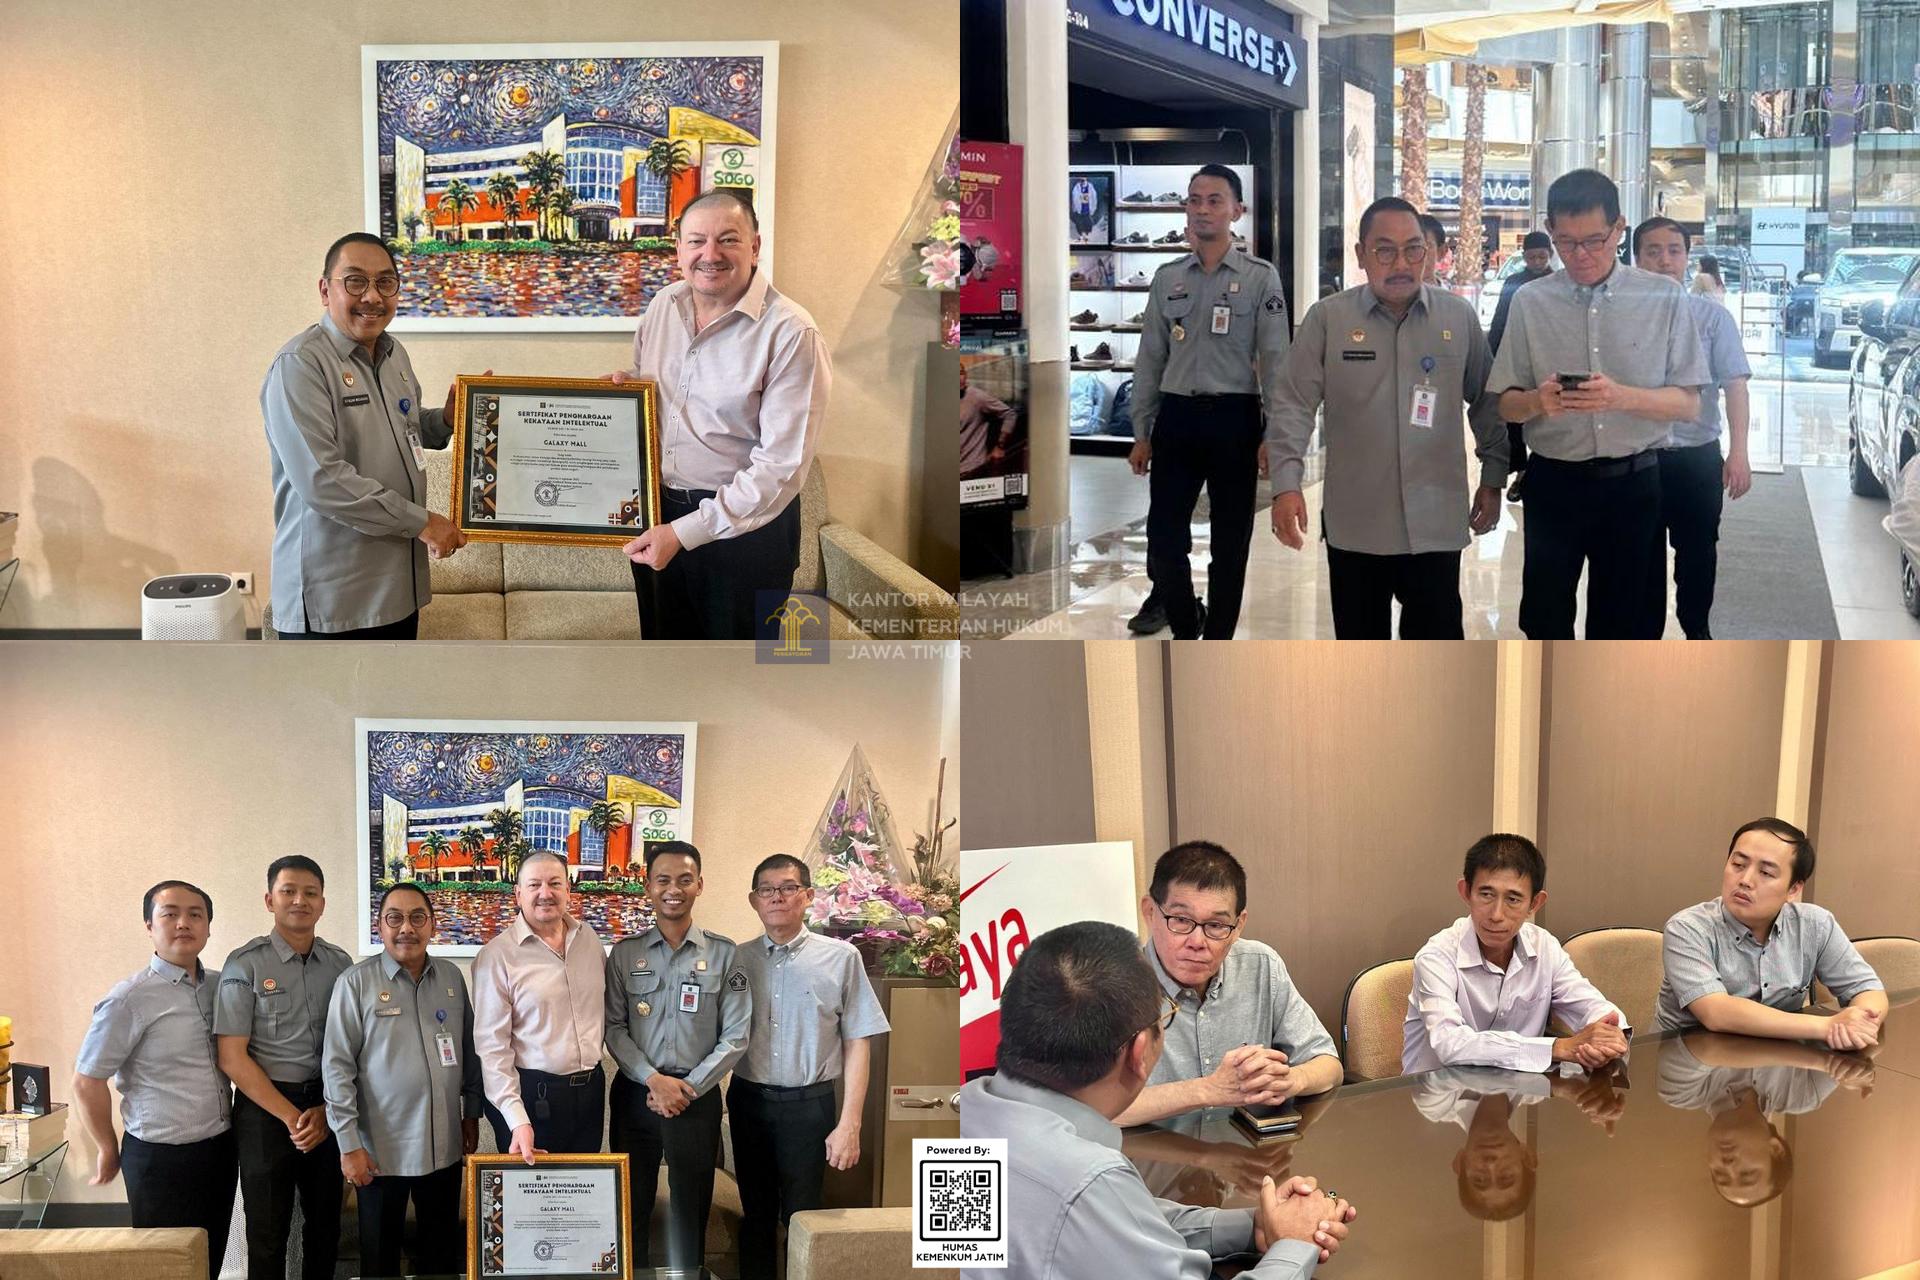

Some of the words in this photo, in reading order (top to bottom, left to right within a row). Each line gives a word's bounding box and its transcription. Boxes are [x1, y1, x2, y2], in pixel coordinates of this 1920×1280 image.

[713, 170, 755, 187] SOGO
[1486, 181, 1532, 201] Wor
[642, 827, 676, 840] SOGO
